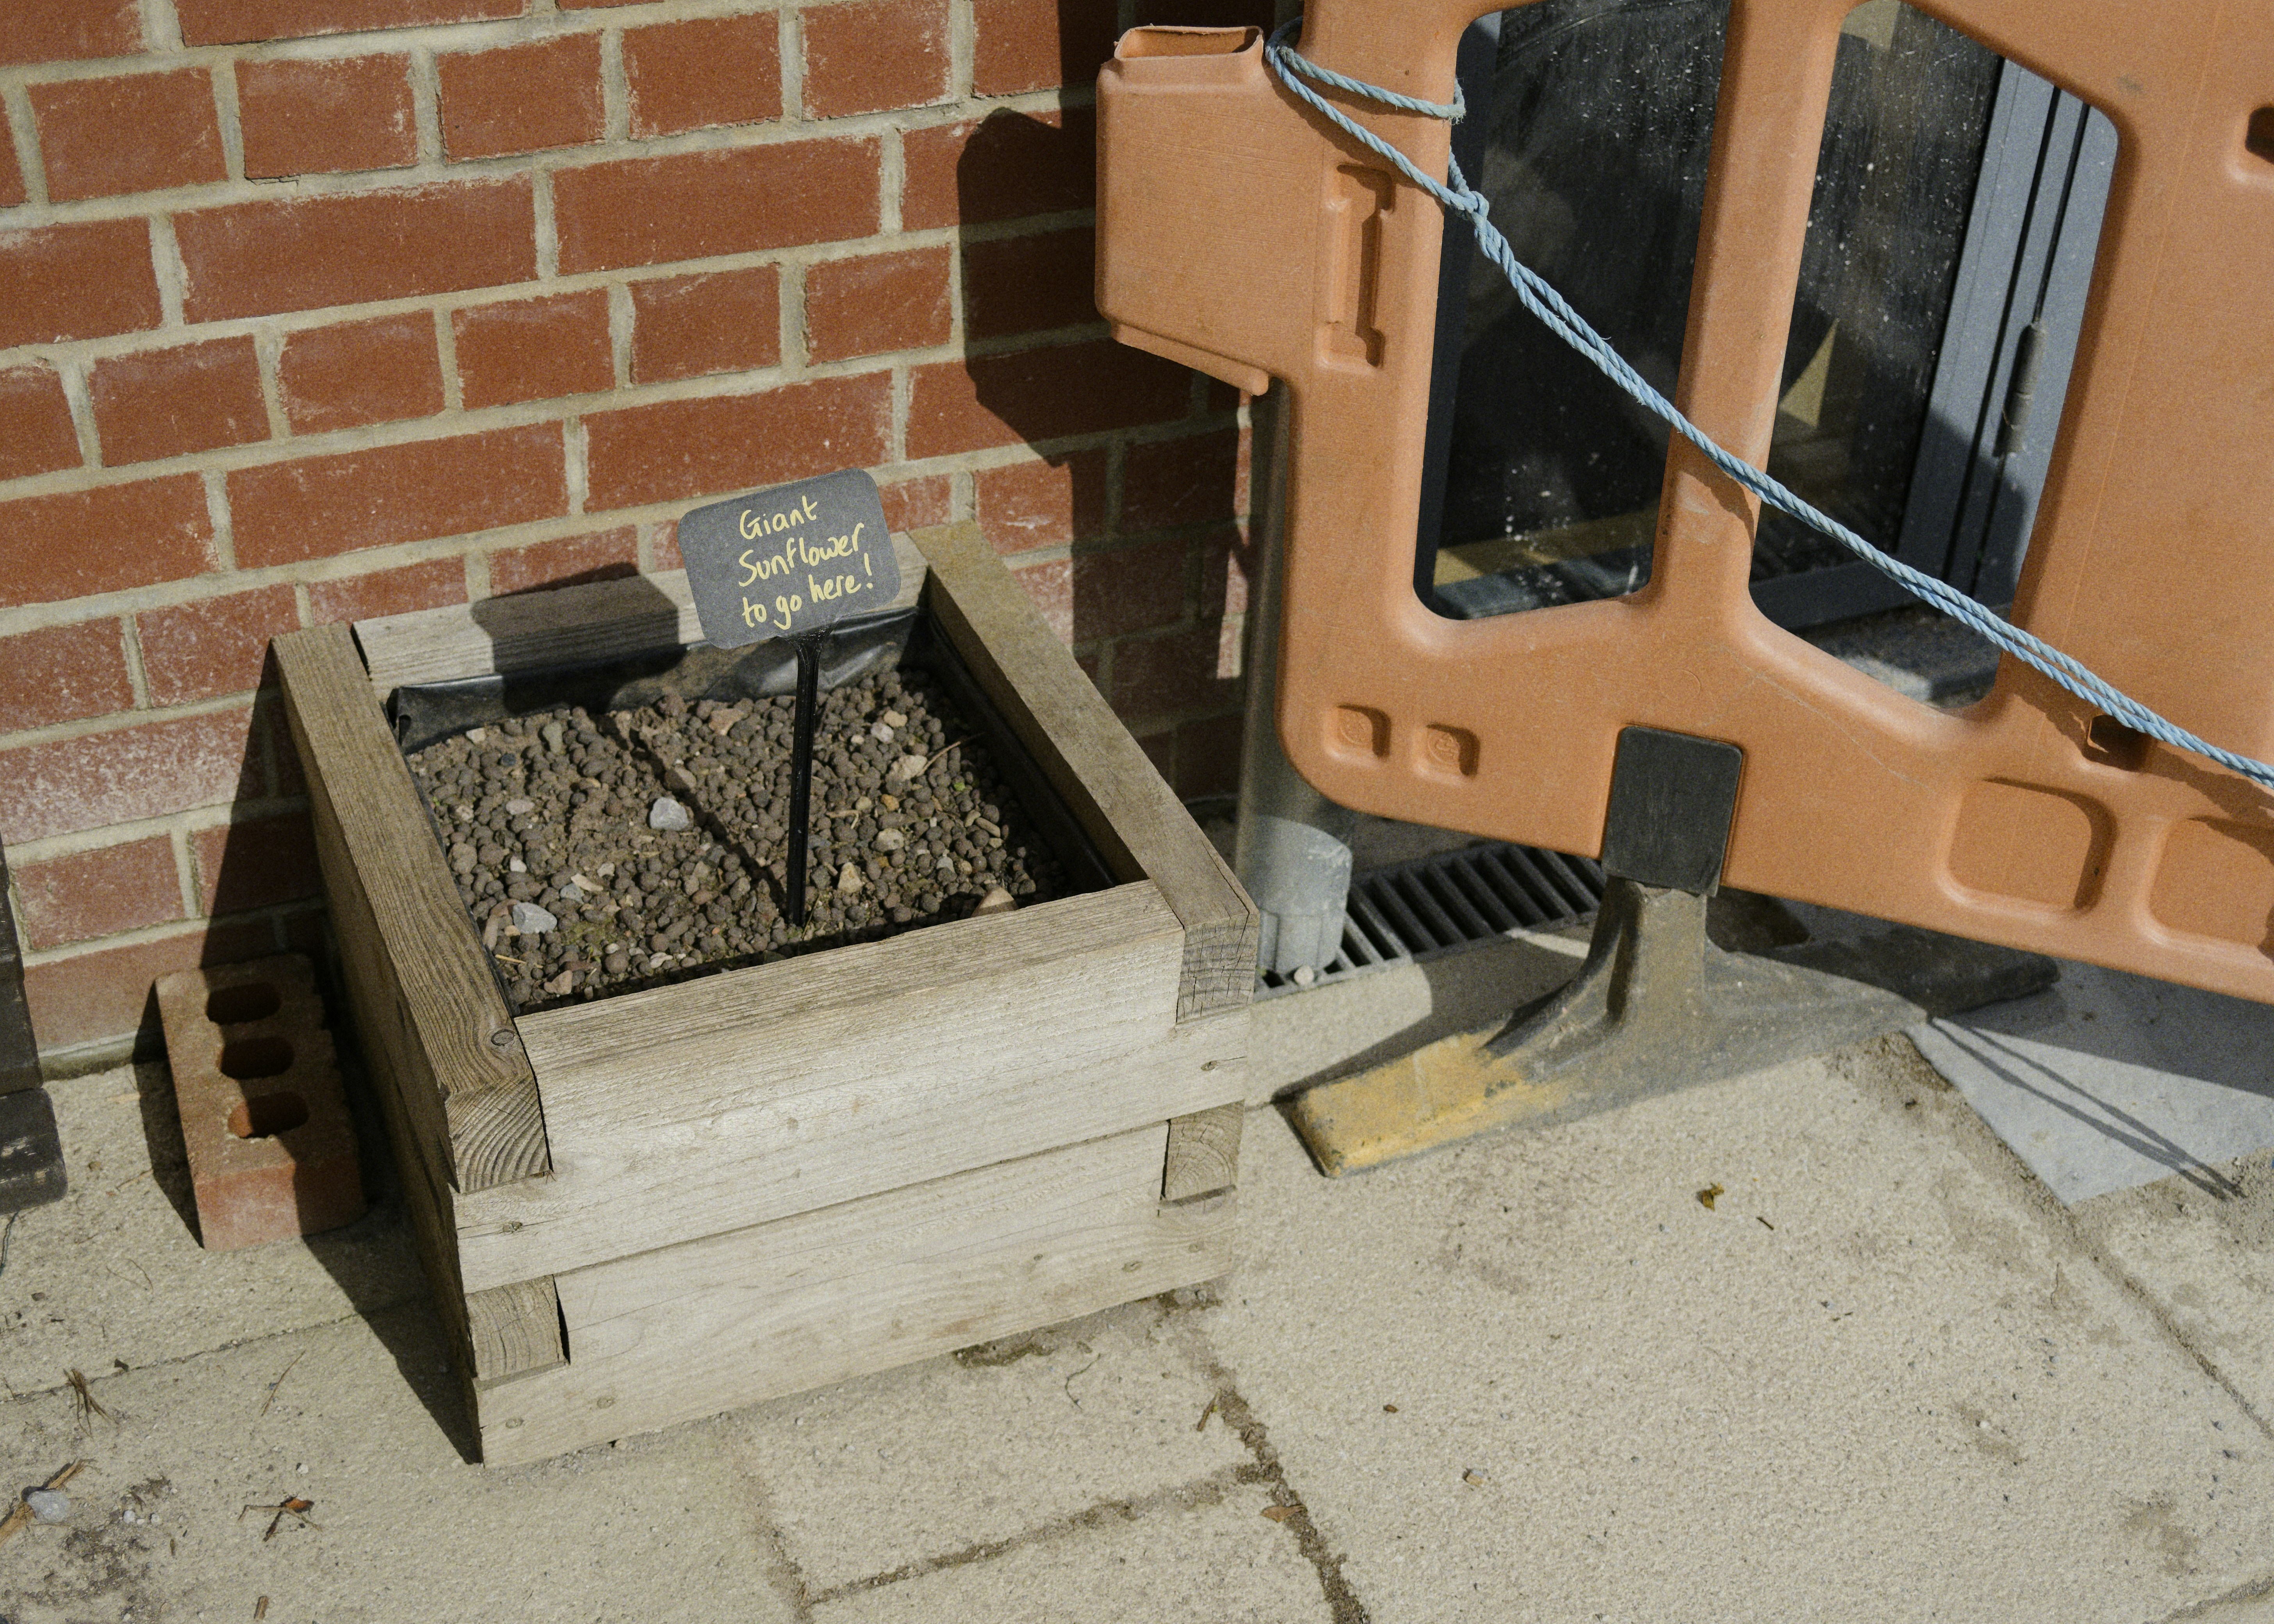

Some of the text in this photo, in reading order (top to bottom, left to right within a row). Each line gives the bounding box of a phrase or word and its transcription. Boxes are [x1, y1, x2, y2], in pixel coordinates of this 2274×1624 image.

[740, 495, 818, 540] Giant
[738, 522, 864, 587] Sunflower
[741, 552, 873, 630] to go here!
